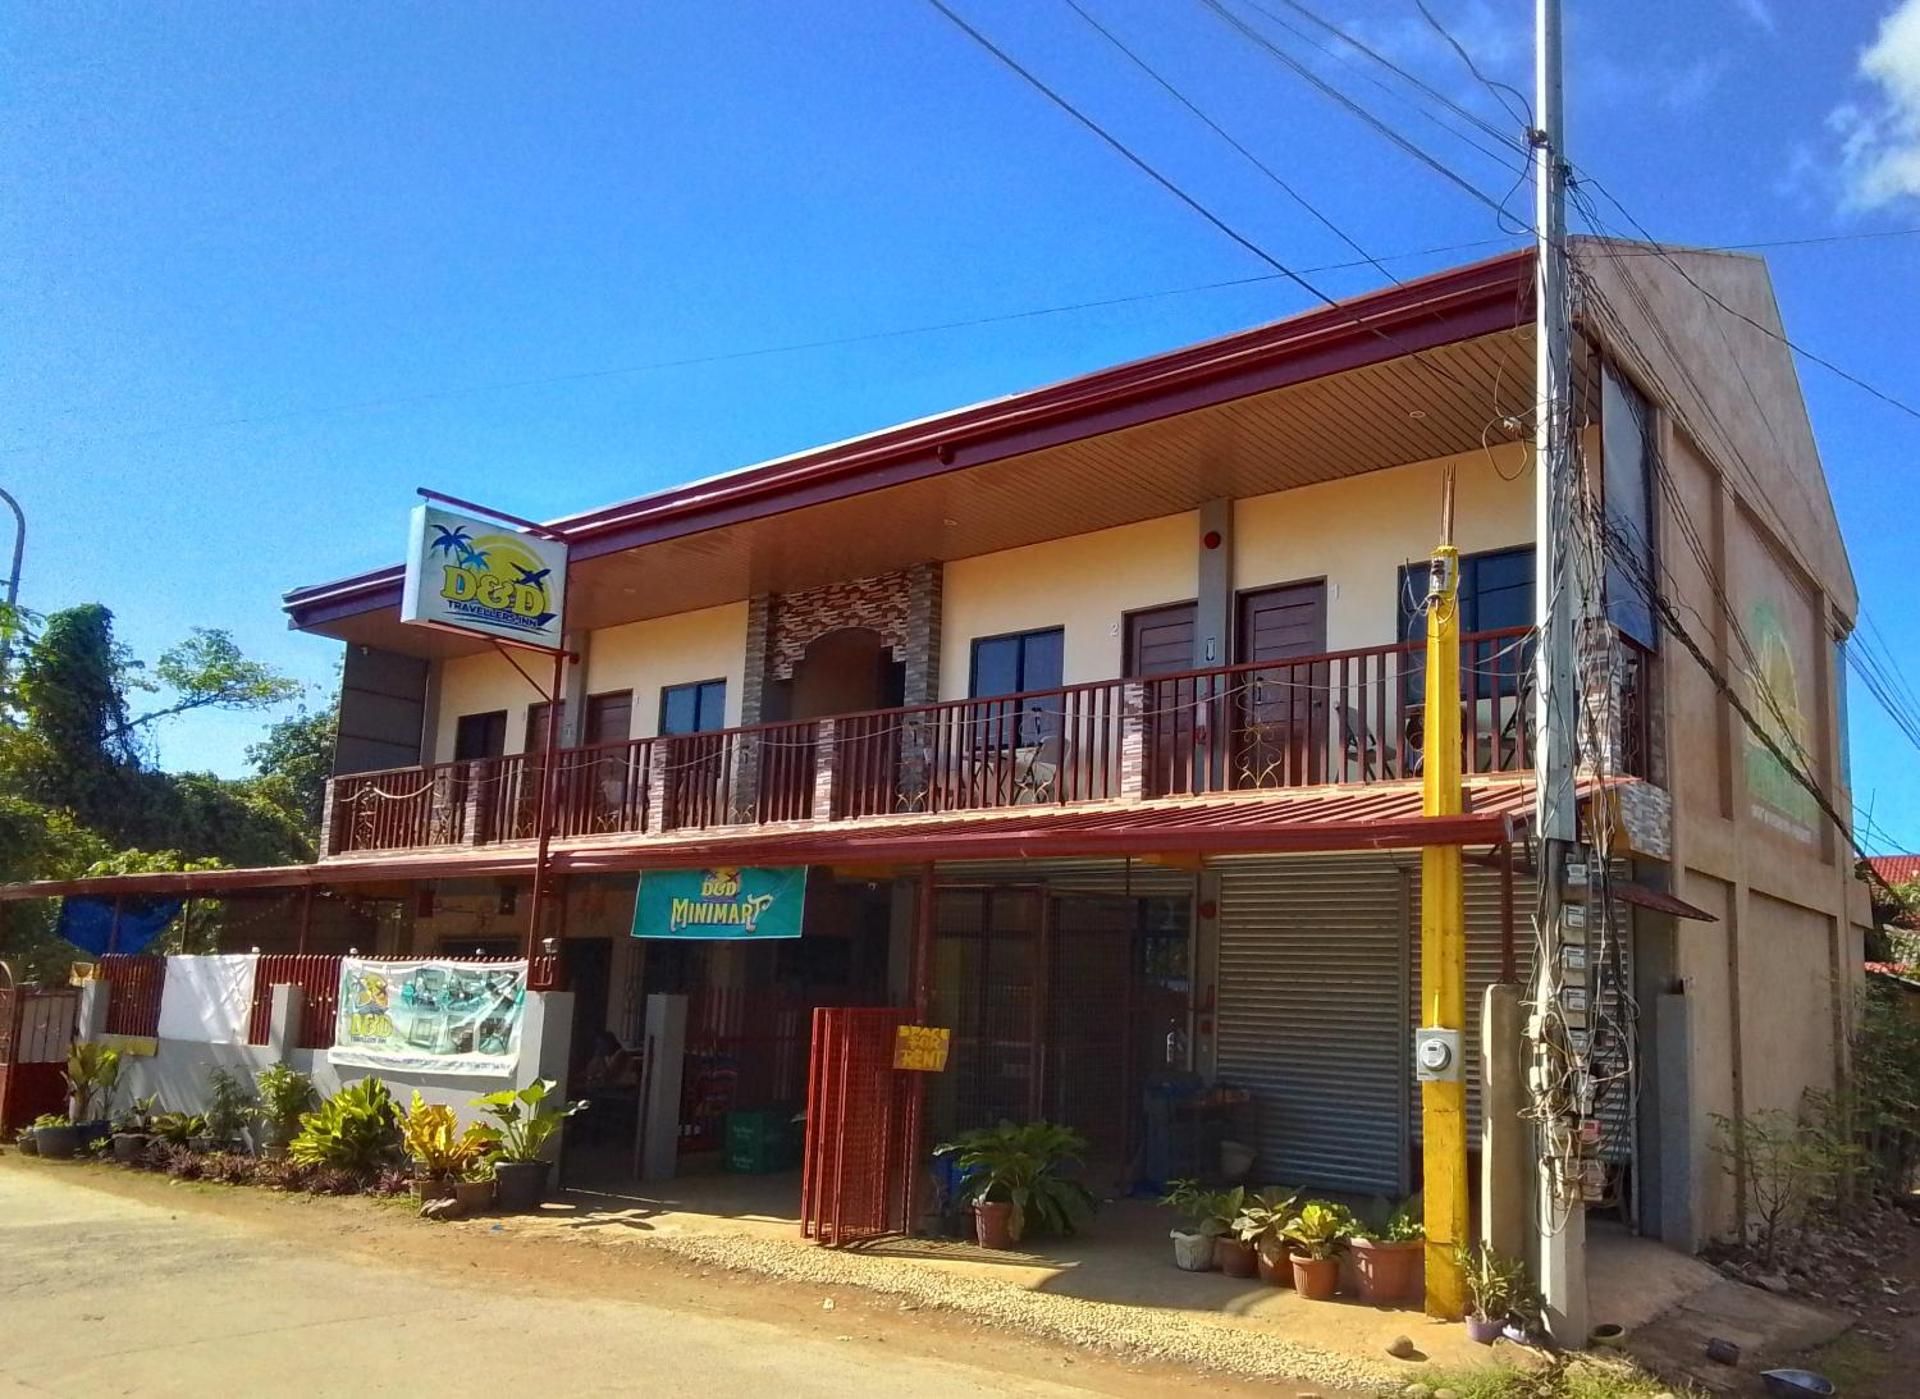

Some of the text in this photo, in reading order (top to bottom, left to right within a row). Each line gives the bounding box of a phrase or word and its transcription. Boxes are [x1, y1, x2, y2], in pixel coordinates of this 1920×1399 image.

[441, 566, 544, 616] D&D
[518, 615, 538, 628] INN
[702, 882, 738, 896] D&D
[671, 894, 774, 932] MINIMART
[907, 1035, 941, 1049] FOR
[900, 1049, 947, 1069] RENT
